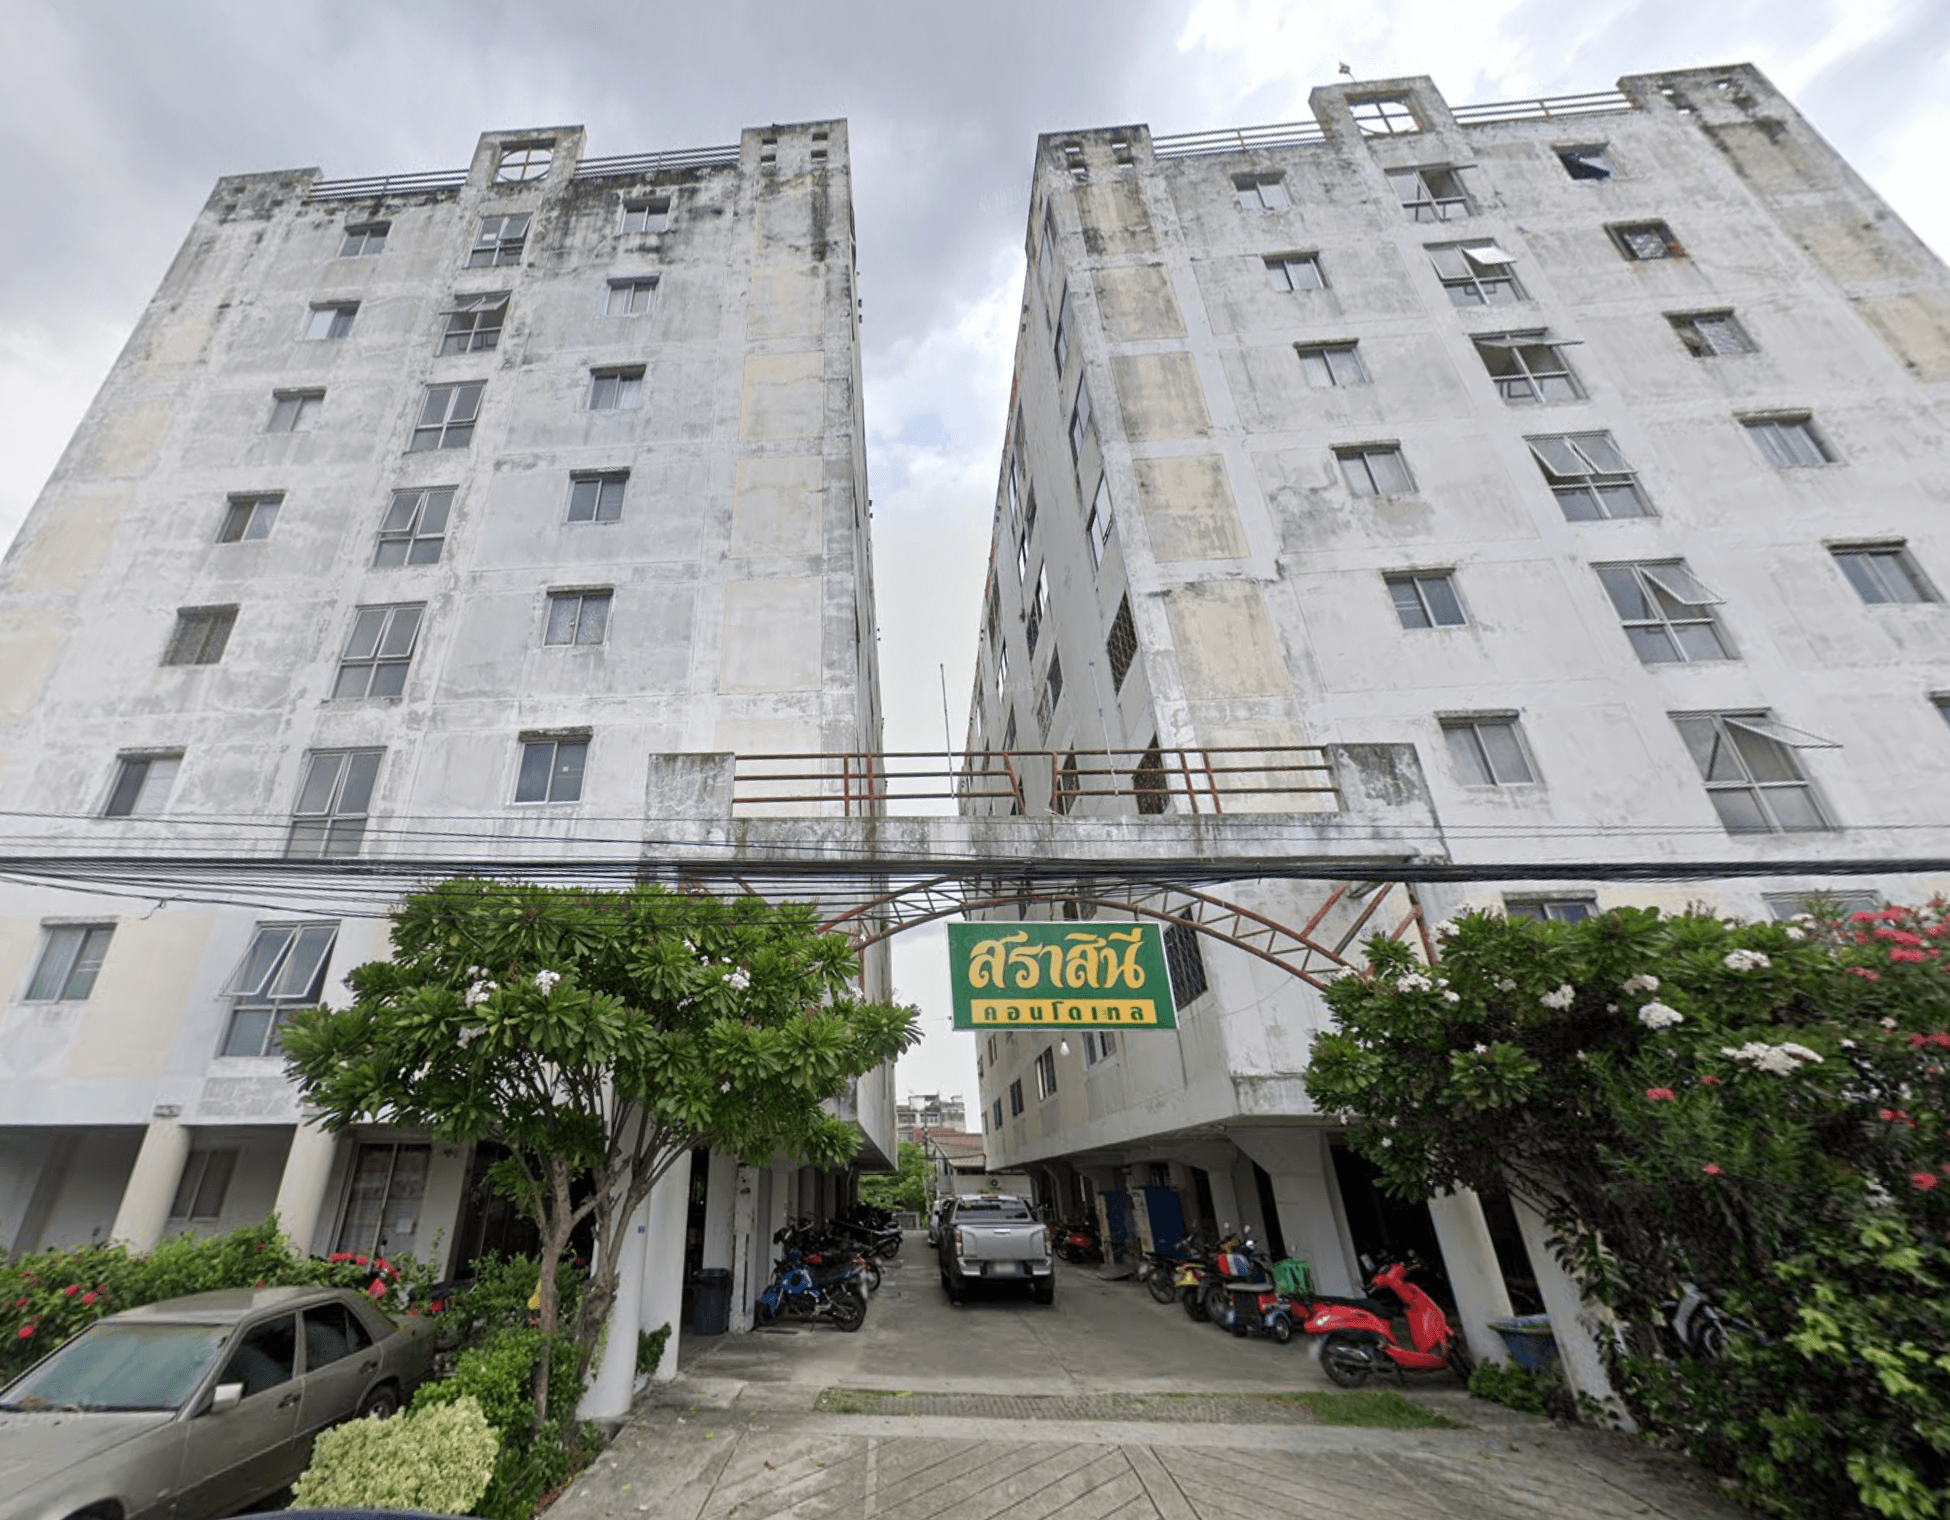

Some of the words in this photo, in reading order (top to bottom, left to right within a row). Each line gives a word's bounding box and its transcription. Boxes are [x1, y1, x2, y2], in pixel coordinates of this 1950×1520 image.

[968, 928, 1145, 989] สราสินี
[984, 1001, 1144, 1021] คอนโดเทล
